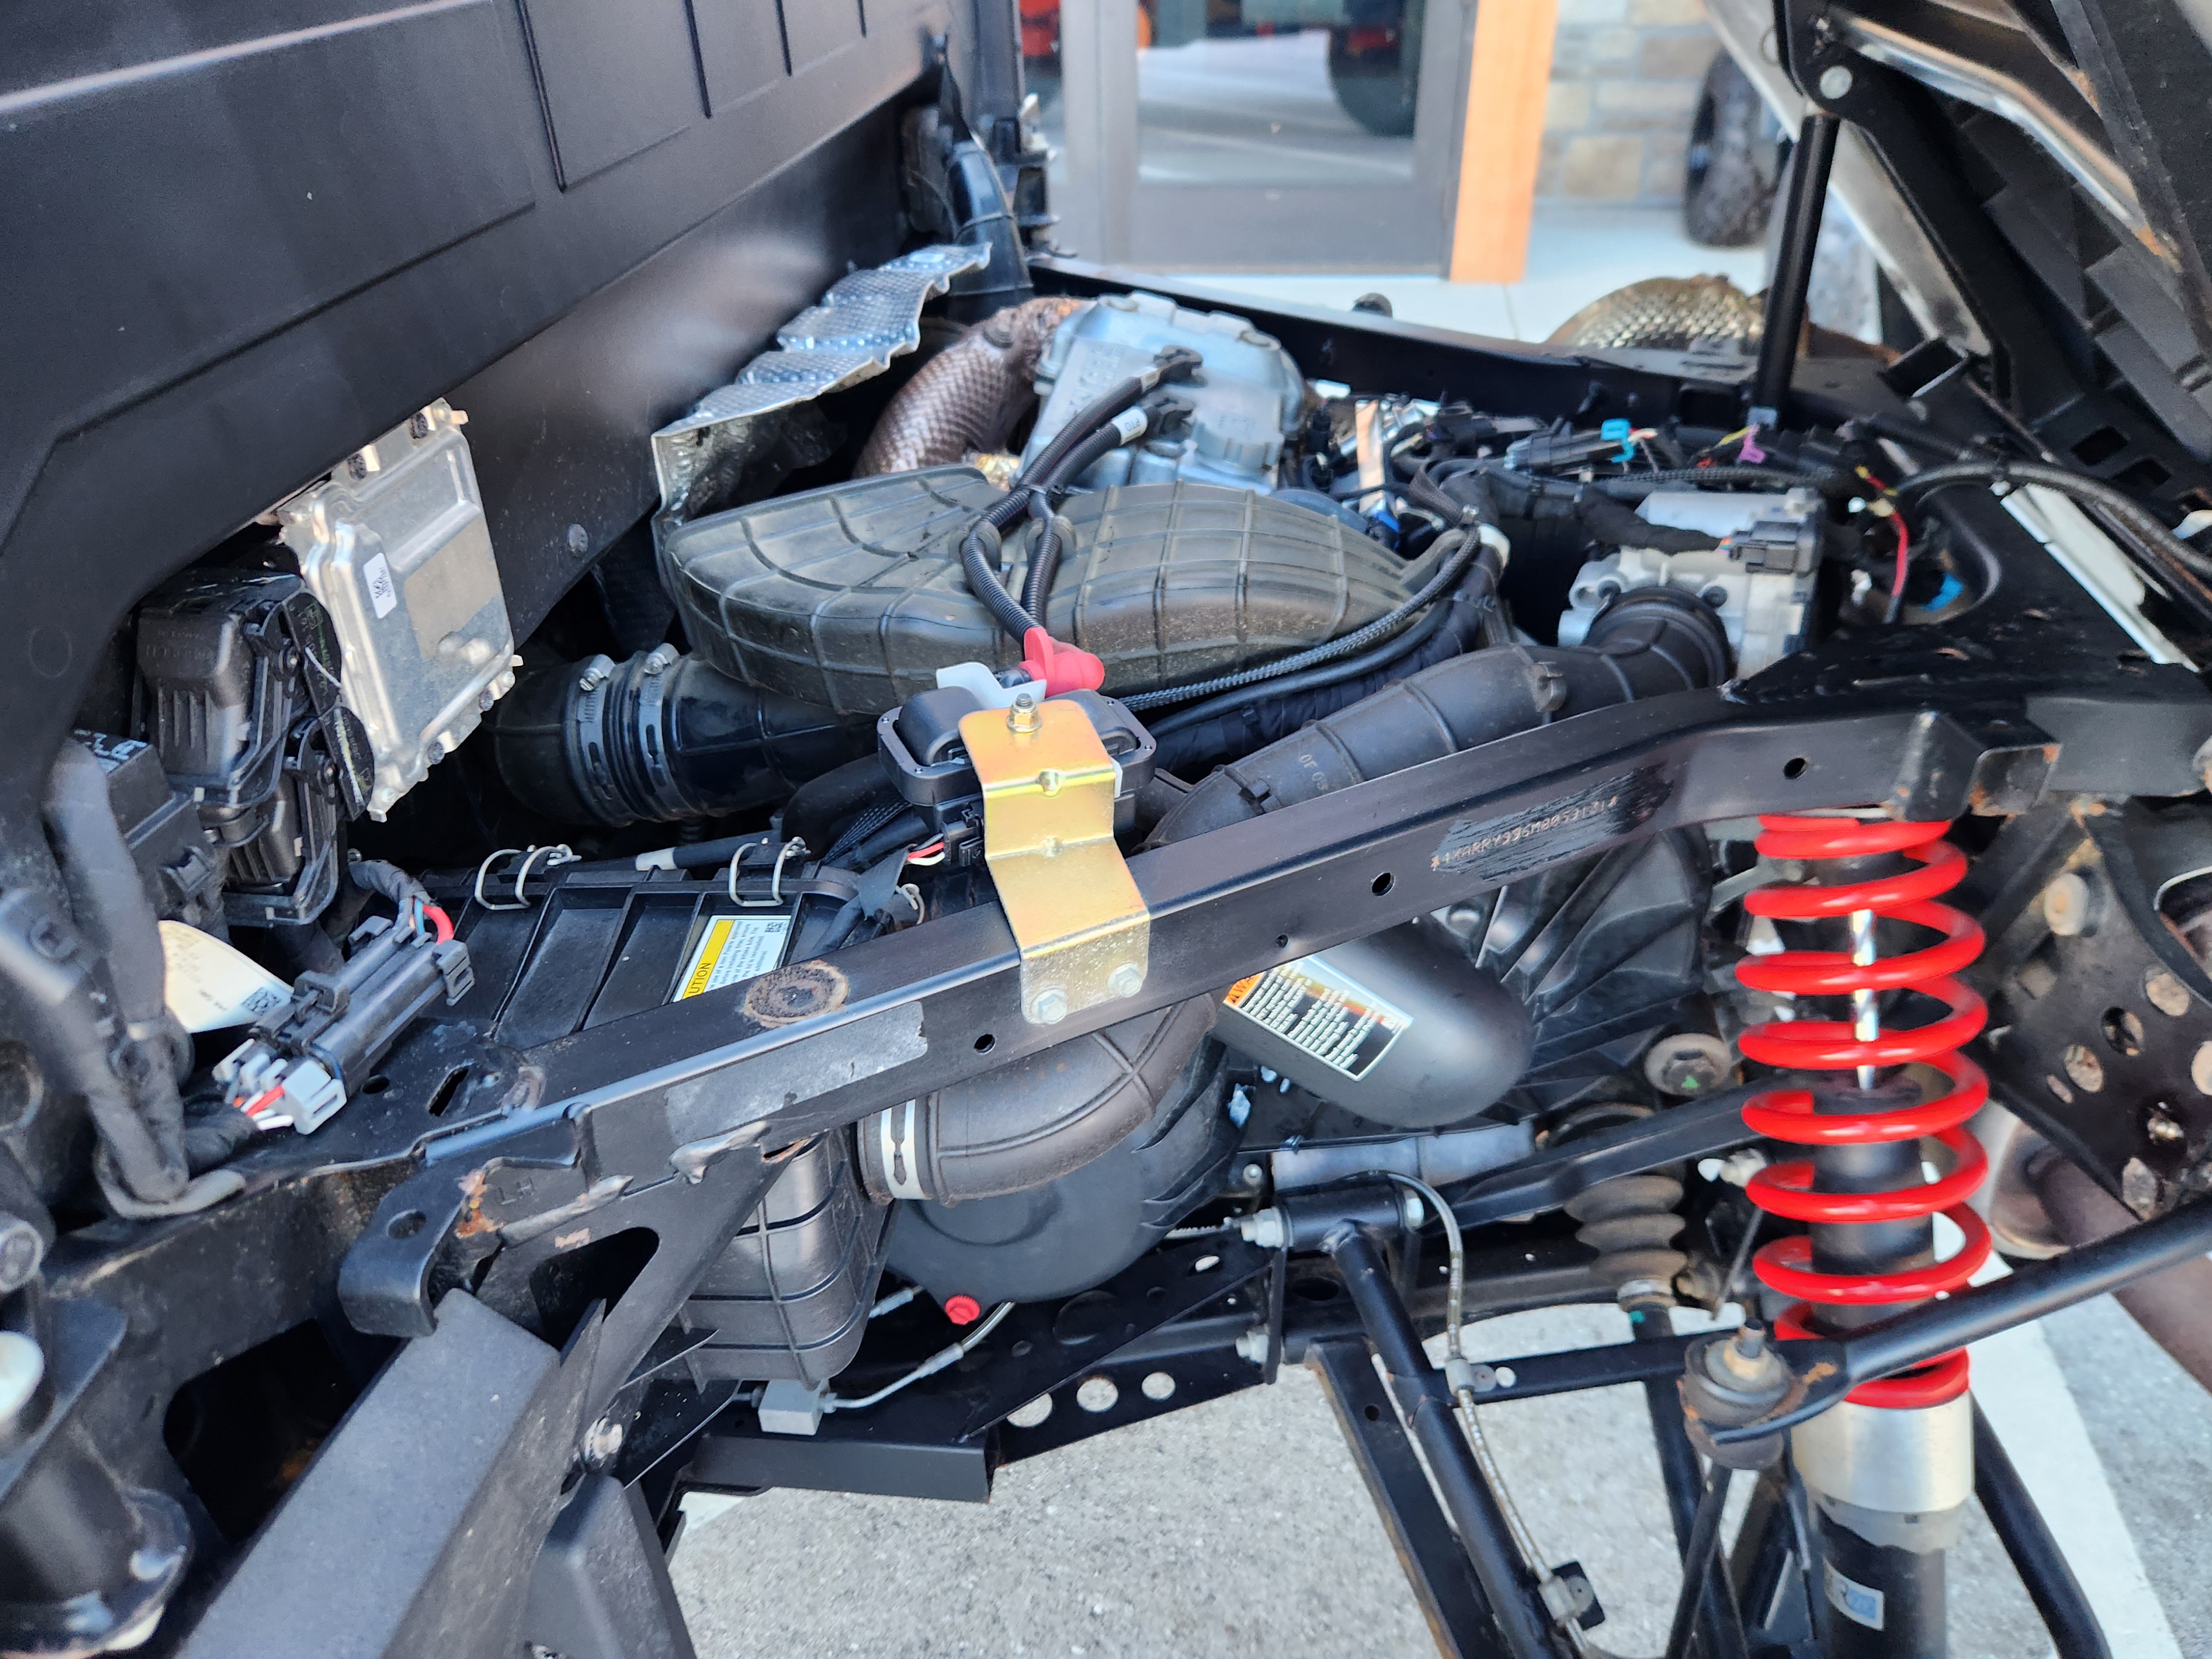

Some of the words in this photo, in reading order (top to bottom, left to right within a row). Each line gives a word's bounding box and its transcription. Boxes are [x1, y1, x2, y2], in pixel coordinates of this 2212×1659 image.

[1124, 418, 1141, 431] PTO
[688, 963, 712, 993] UTION
[498, 1176, 535, 1206] LH
